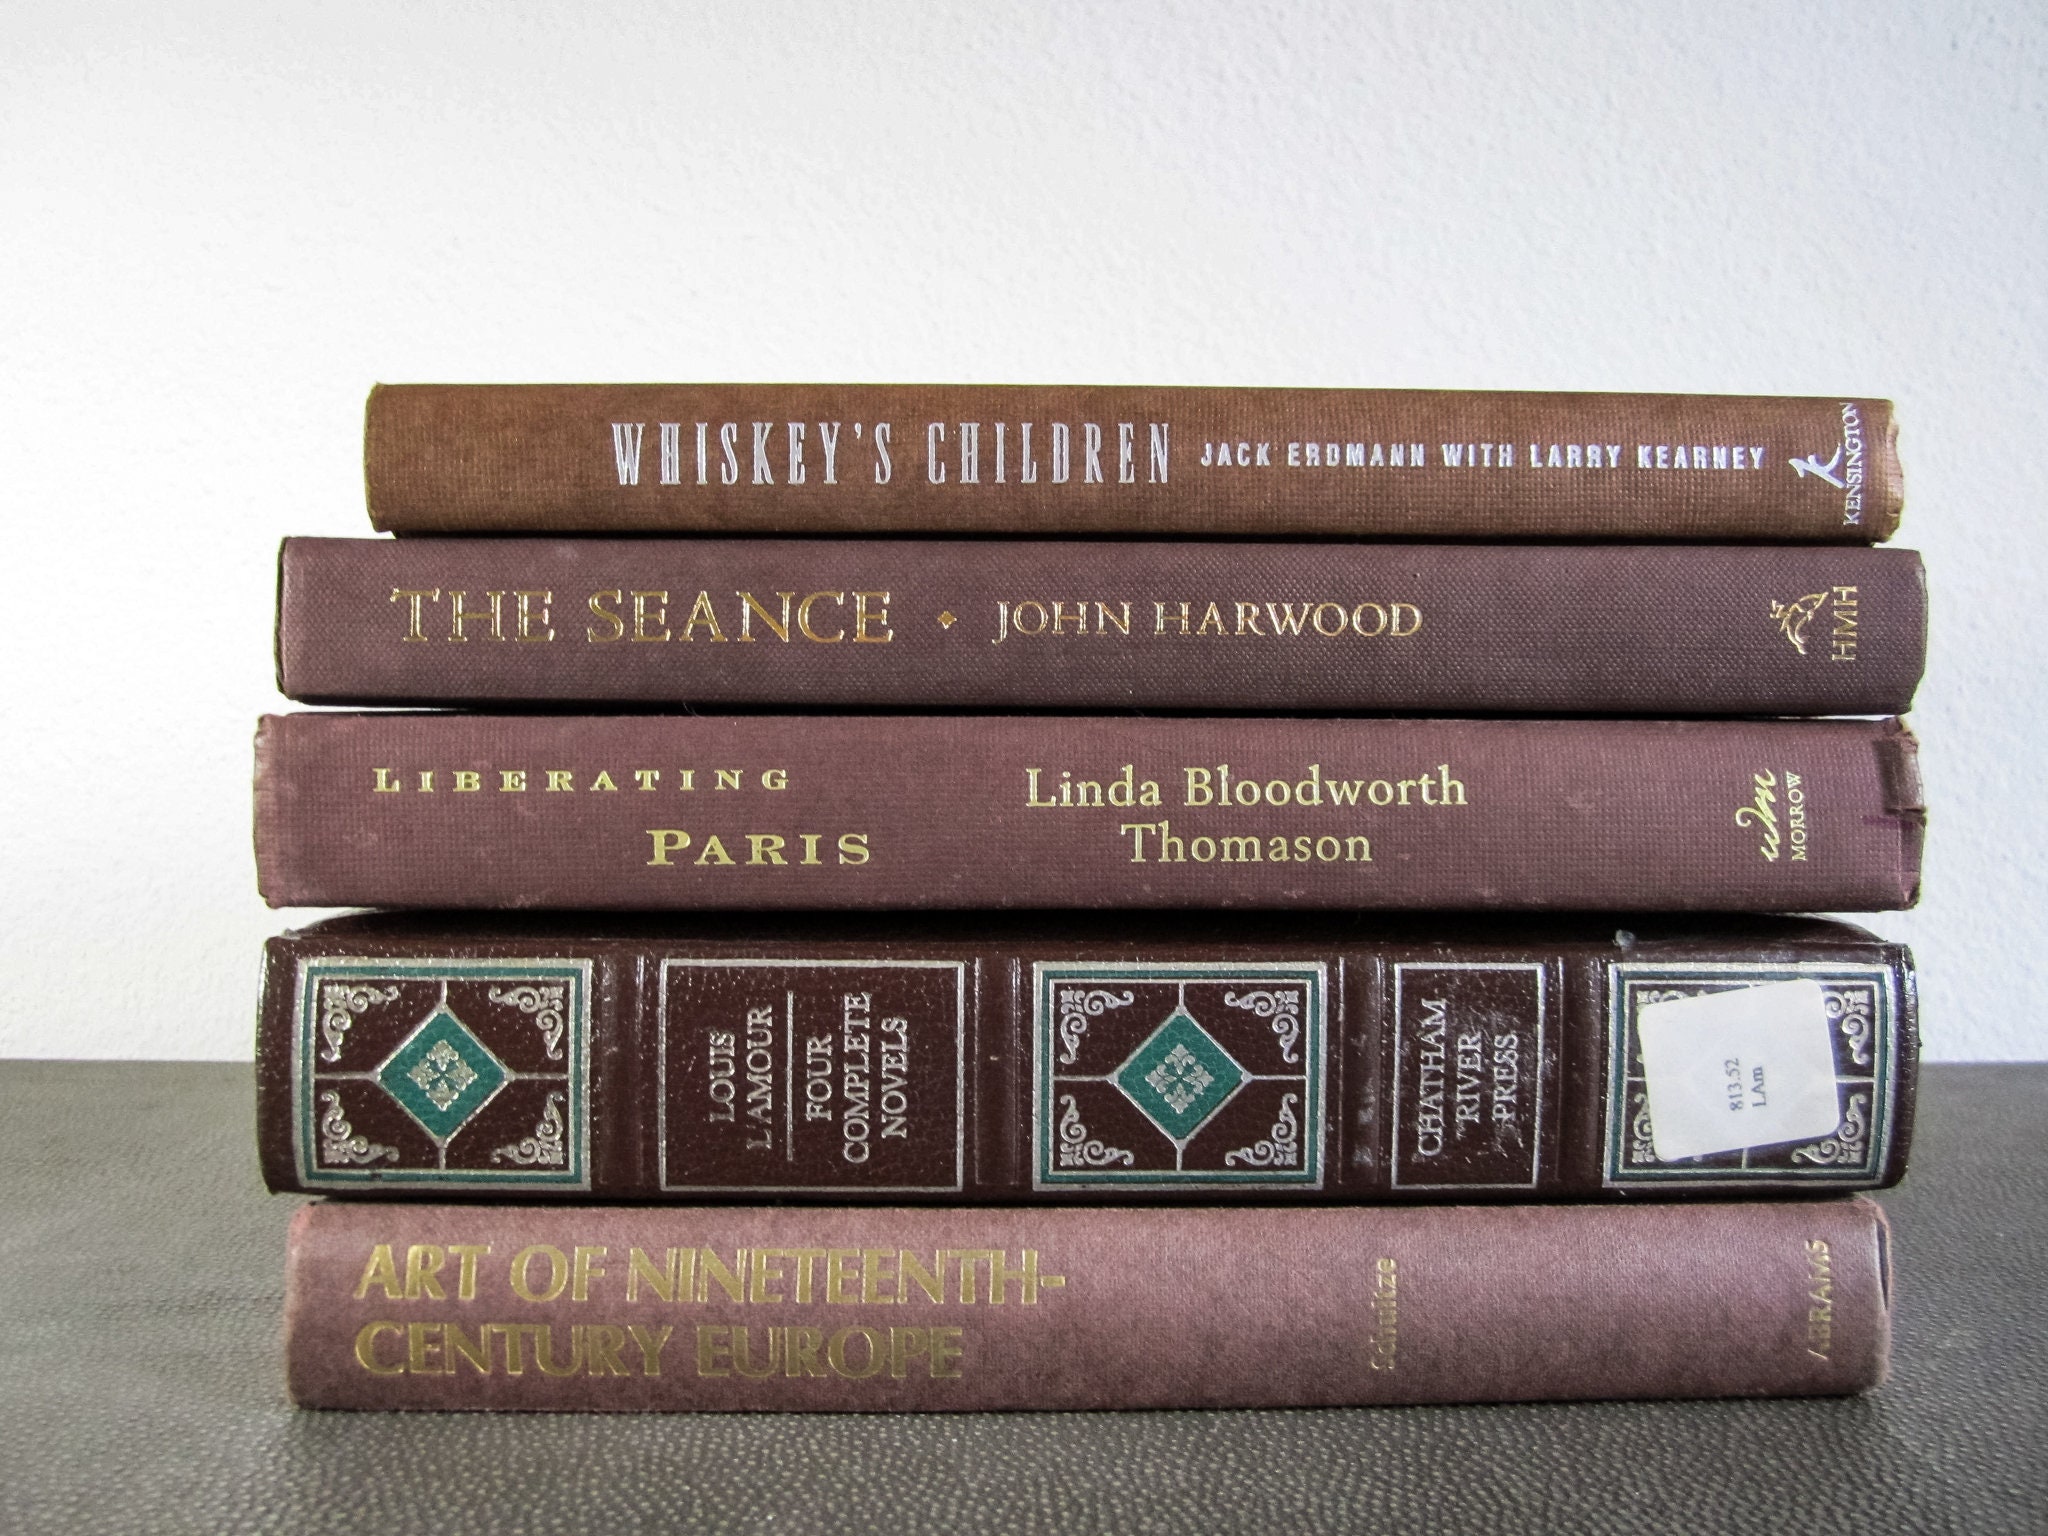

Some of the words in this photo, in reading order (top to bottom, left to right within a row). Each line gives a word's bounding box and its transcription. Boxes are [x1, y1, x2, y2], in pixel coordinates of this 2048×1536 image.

[611, 422, 893, 486] WHISKEY'S
[927, 422, 1170, 484] CHILDREN
[1200, 441, 1271, 468] JACK
[1288, 443, 1425, 469] ERDMANN
[1441, 443, 1513, 468] WITH
[1530, 444, 1622, 469] LARRY
[1637, 446, 1766, 470] KEARNEY
[1840, 402, 1863, 526] KENSINGTON
[390, 587, 556, 643] THE
[585, 590, 894, 643] SEANCE
[992, 600, 1130, 645] JOHN
[1154, 601, 1424, 637] HARWOOD
[1831, 585, 1858, 661] HMH
[372, 767, 789, 793] LIBERATING
[1026, 764, 1163, 808] Linda
[1183, 764, 1469, 806] Bloodworth
[646, 828, 871, 866] PARIS
[1120, 820, 1373, 863] Thomason
[1786, 771, 1808, 861] MORROW
[709, 1031, 735, 1123] LOUIS
[806, 1034, 832, 1122] FOUR
[844, 992, 871, 1163] COMPLETE
[881, 1016, 908, 1139] NOVELS
[1418, 998, 1447, 1156] CHATHAM
[1456, 1032, 1482, 1123] RIVER
[1492, 1033, 1518, 1122] PRESS
[1724, 1057, 1744, 1112] 813.52
[354, 1244, 491, 1301] ART
[510, 1244, 607, 1302] OF
[626, 1246, 1066, 1305] NINETEENTH-
[1804, 1240, 1832, 1360] ABRAMS
[355, 1320, 673, 1376] CENTURY
[697, 1326, 962, 1378] EUROPE
